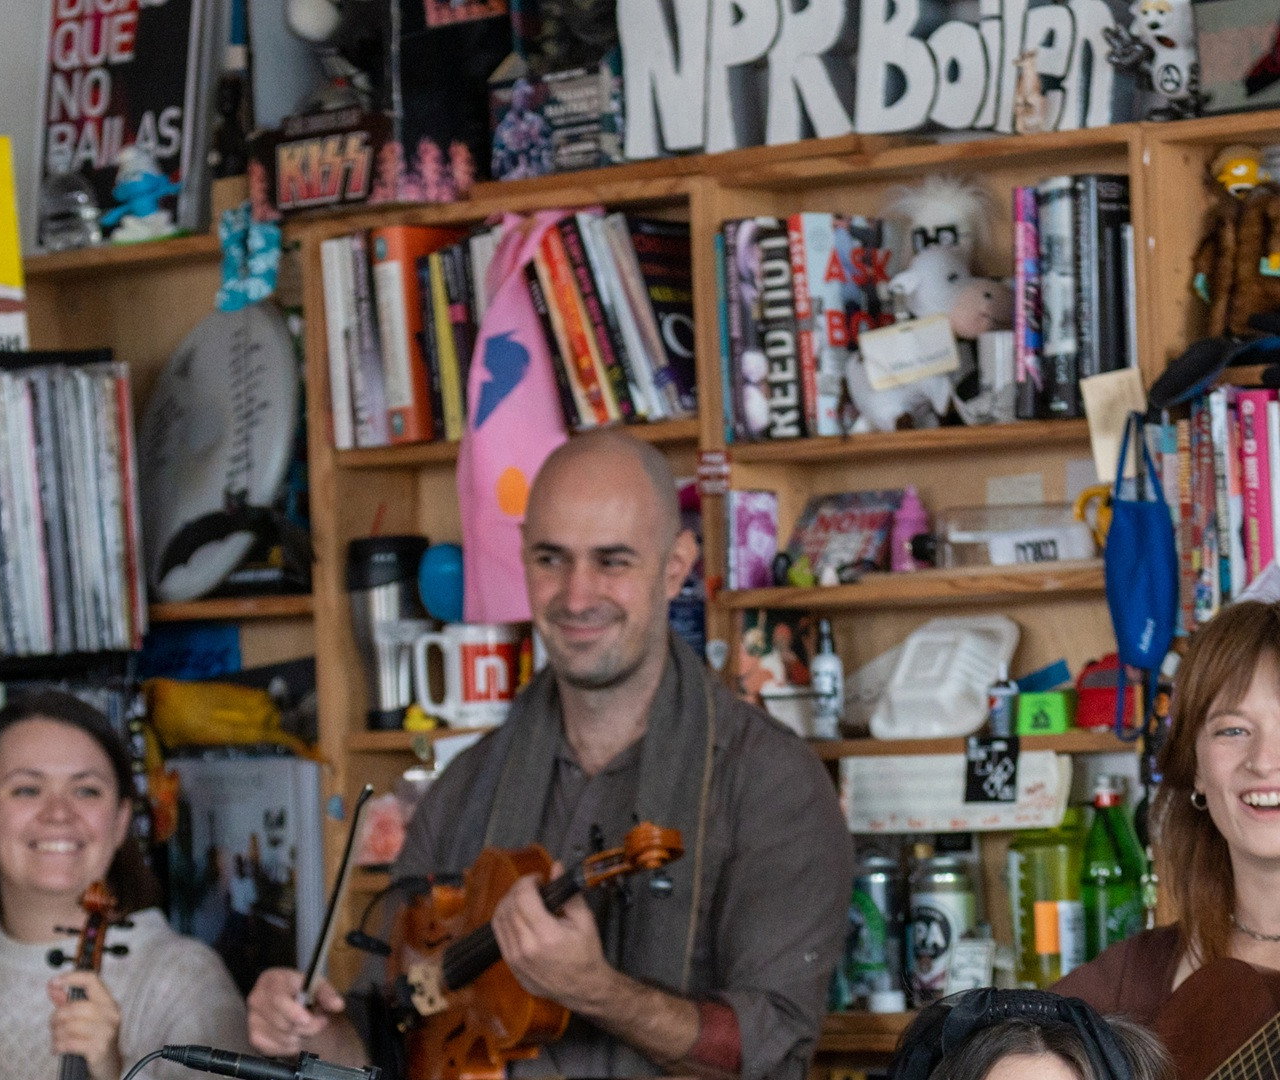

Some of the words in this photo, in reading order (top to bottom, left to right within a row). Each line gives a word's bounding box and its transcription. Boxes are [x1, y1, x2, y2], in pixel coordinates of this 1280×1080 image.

[51, 11, 138, 70] QUE
[50, 67, 112, 122] NO
[616, 0, 854, 160] NPR
[855, 0, 1117, 134] Boilen
[277, 130, 372, 210] KISS
[823, 247, 893, 286] ASK
